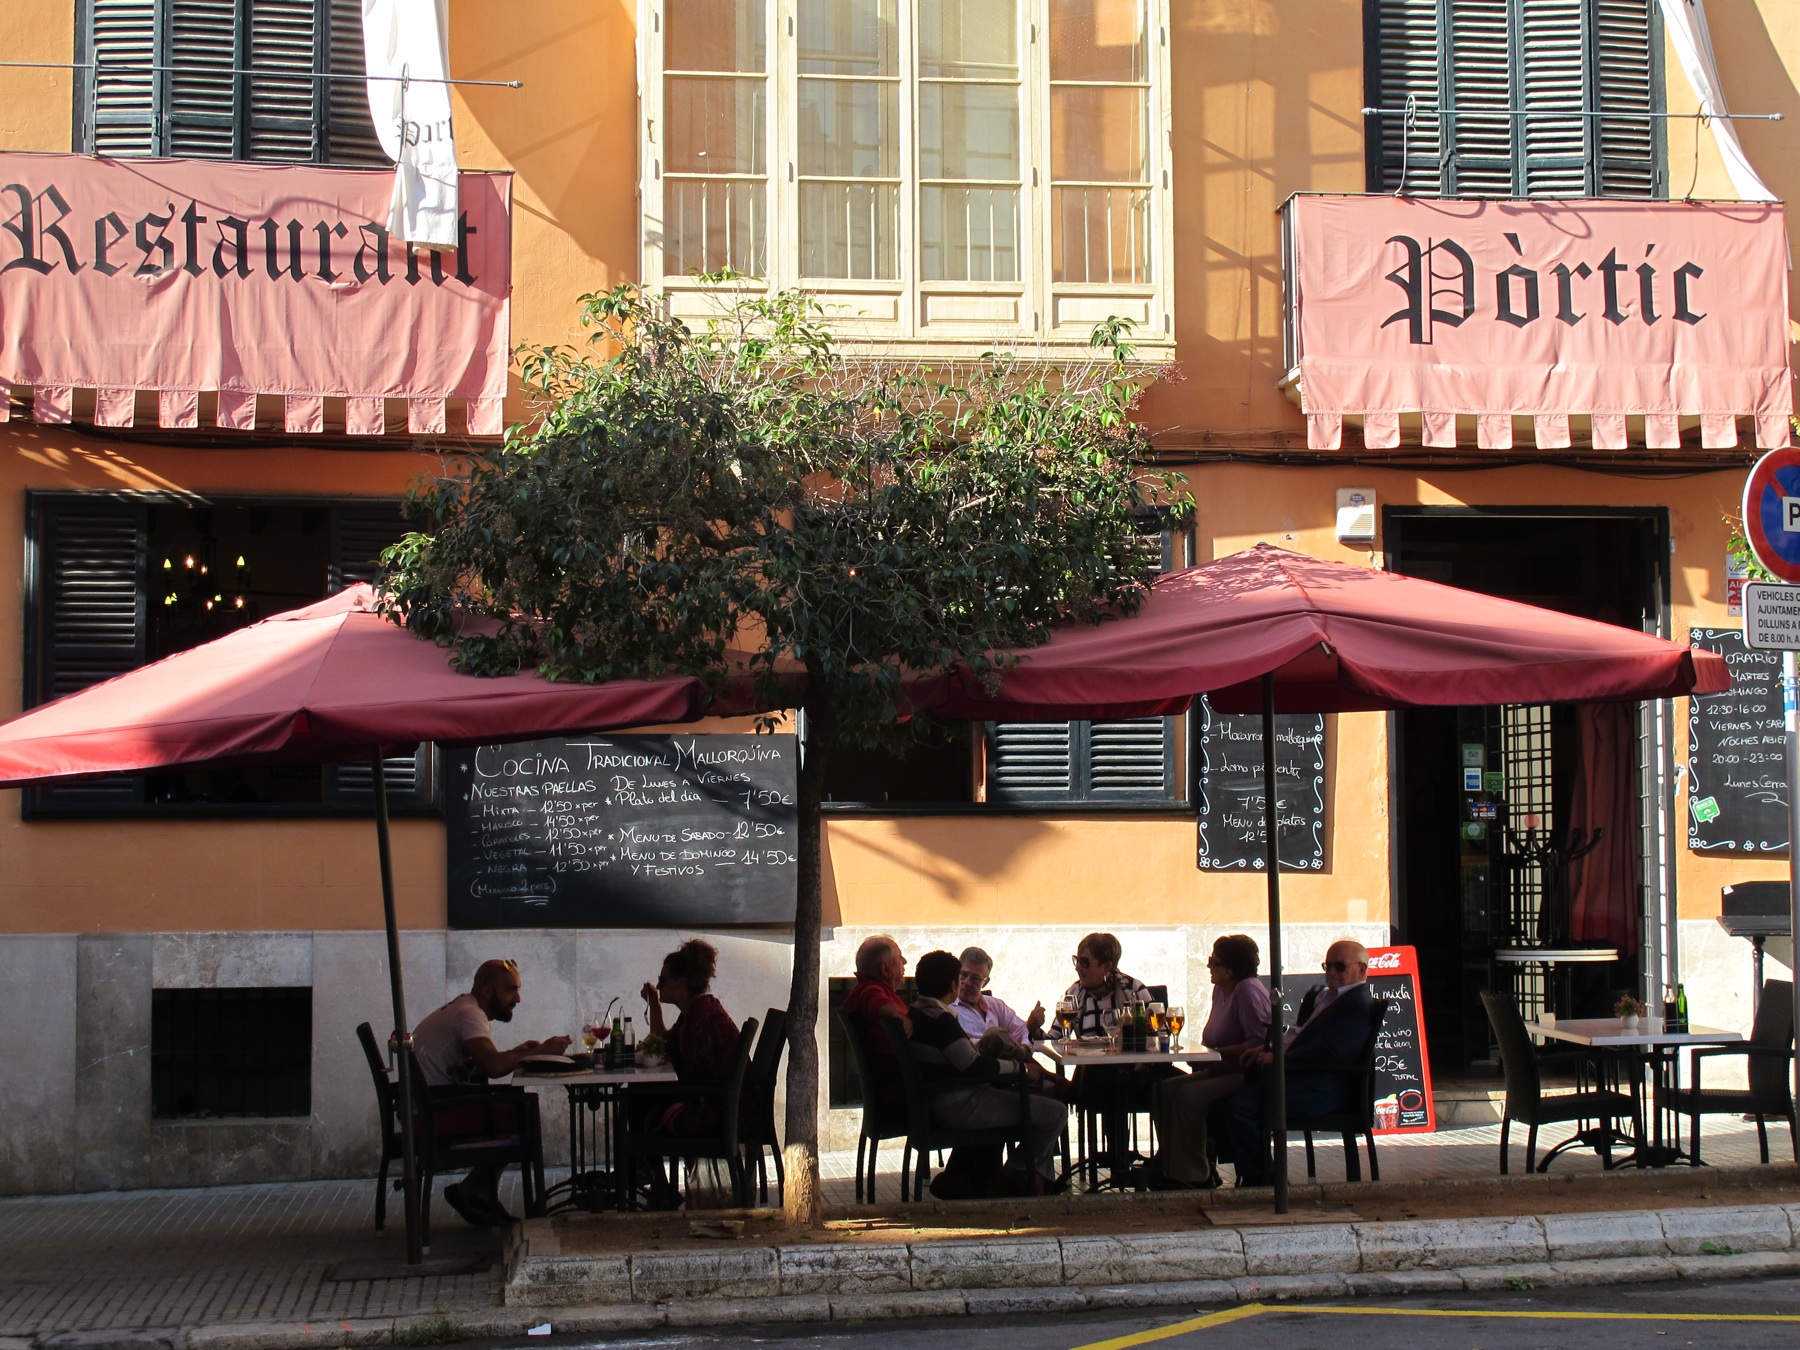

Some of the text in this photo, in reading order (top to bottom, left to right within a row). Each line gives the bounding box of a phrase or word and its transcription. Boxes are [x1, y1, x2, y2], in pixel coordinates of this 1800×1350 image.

[1380, 232, 1708, 346] Pòrtic
[1757, 590, 1794, 602] VEHICLES
[1758, 618, 1790, 630] DILLUNS
[1791, 620, 1797, 630] A
[1758, 632, 1769, 643] DE
[1770, 633, 1785, 644] 8.00
[1709, 720, 1752, 732] VIERNES
[1755, 720, 1764, 730] Y
[1717, 735, 1759, 748] NOCHES
[566, 742, 671, 771] TRADICIONAL
[697, 771, 751, 785] VIERNES
[1759, 774, 1788, 789] Cerra
[471, 780, 597, 800] NUESTRAS PAELLAS
[615, 790, 654, 807] Plato
[658, 790, 679, 803] del
[1237, 796, 1288, 810] 7'5€
[619, 827, 660, 844] MENU
[662, 833, 677, 843] DE
[681, 828, 726, 842] SABADO
[1239, 829, 1268, 843] 12'5
[620, 847, 656, 861] MENU
[660, 851, 677, 861] DE
[630, 863, 705, 877] Y FESTIVOS
[1374, 1055, 1408, 1072] 25€
